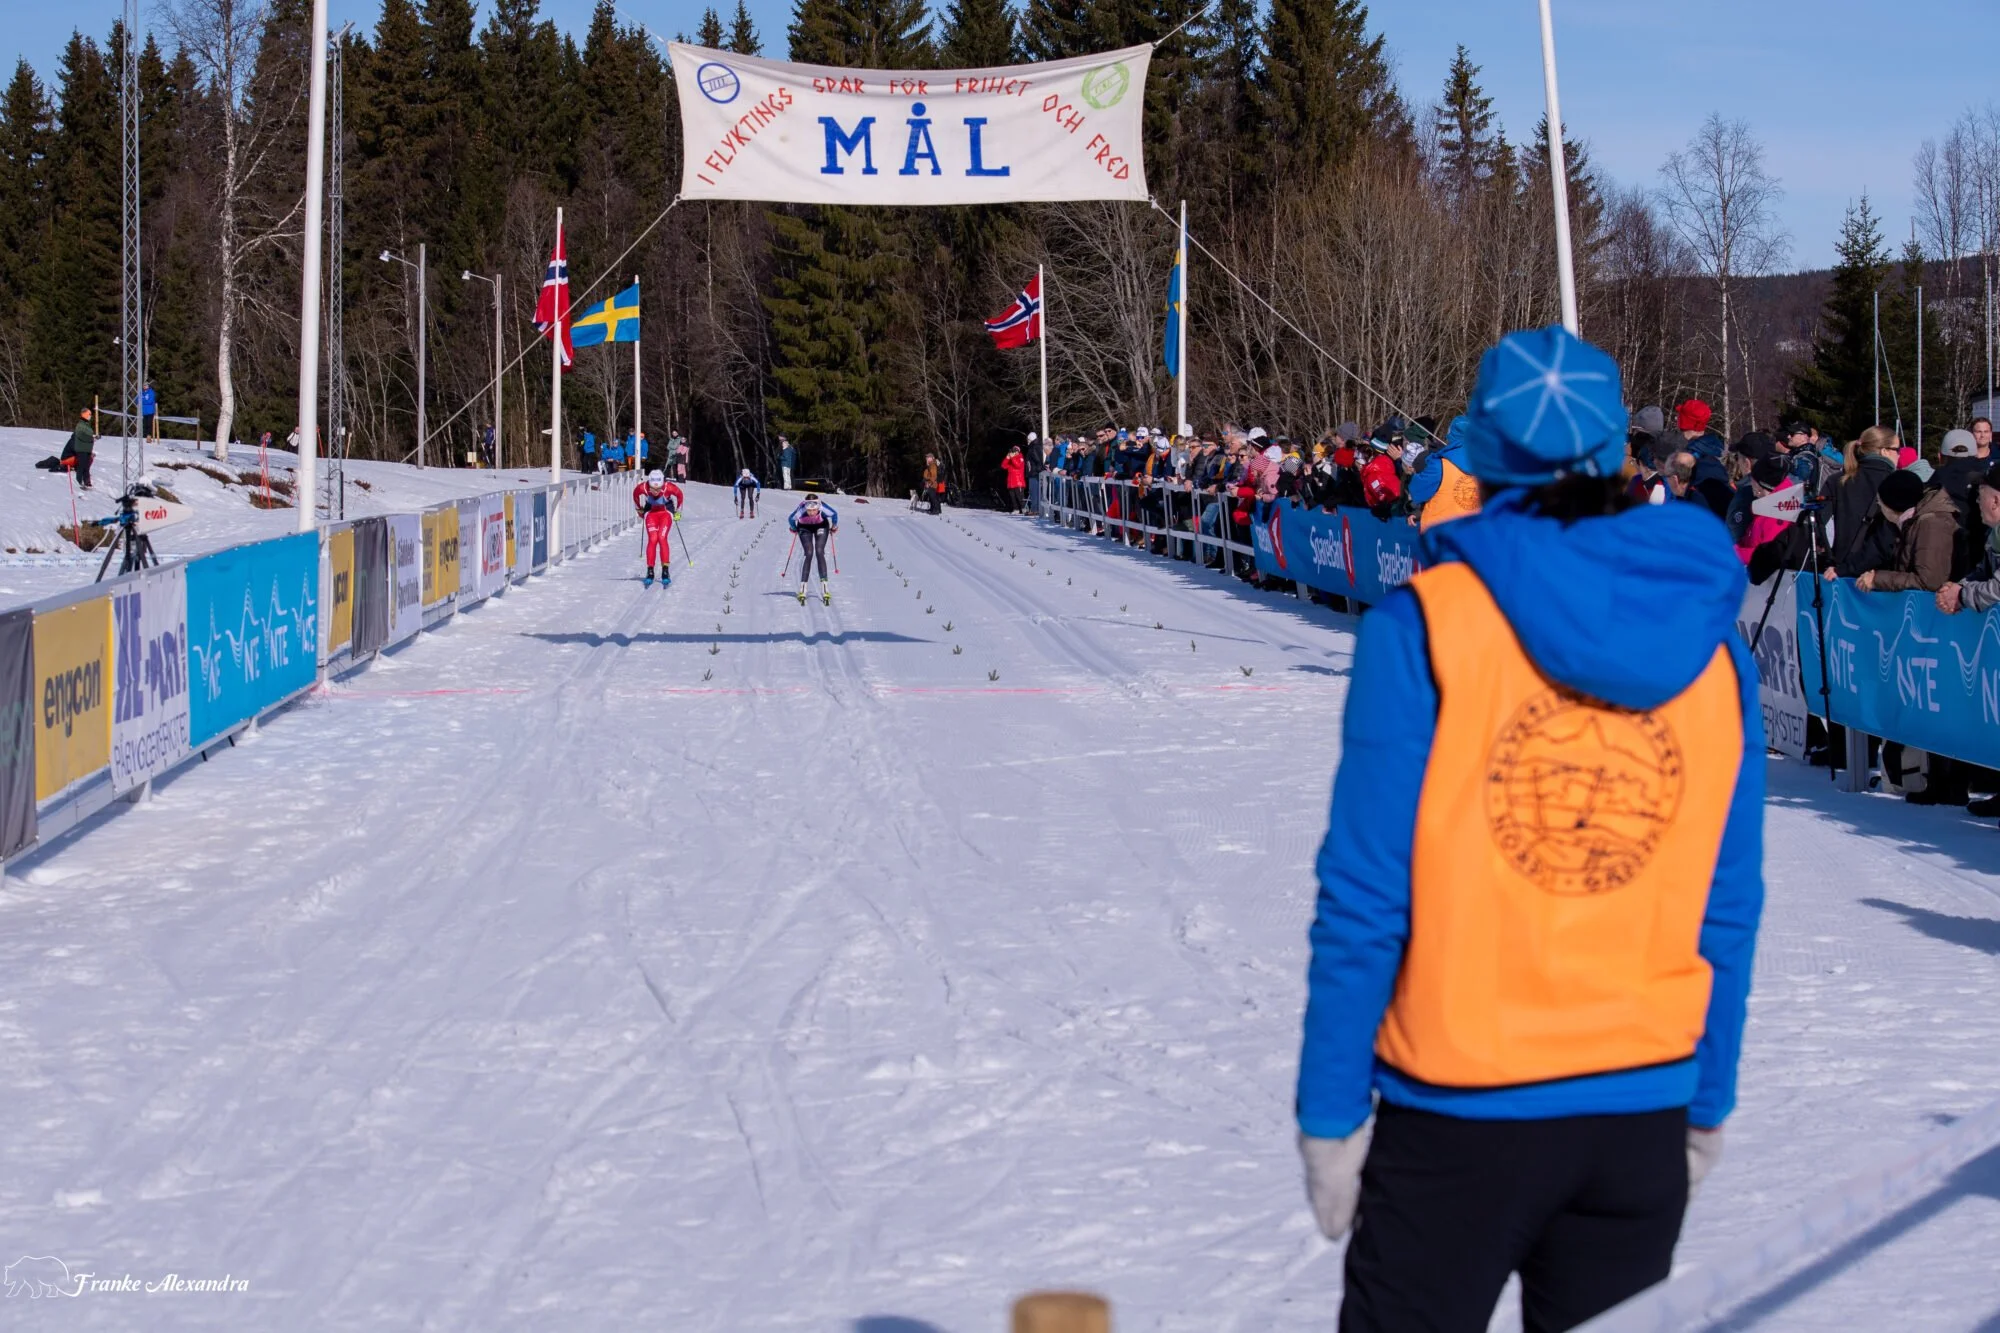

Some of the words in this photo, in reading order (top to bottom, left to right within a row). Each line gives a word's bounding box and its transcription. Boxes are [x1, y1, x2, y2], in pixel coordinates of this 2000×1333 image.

[812, 76, 865, 94] SPÅR
[889, 77, 928, 95] FÖR
[955, 76, 1033, 96] FRIHET
[705, 87, 792, 173] FLYKTINGS
[1043, 94, 1085, 134] OCH
[818, 102, 1010, 177] MÅL
[1086, 133, 1129, 179] FRED
[697, 173, 715, 185] I
[145, 506, 167, 520] emit
[1309, 525, 1346, 575] SpareBank
[270, 625, 288, 670] NTE
[1829, 637, 1859, 695] NTE
[43, 659, 101, 738] engcon
[208, 651, 221, 702] NE
[1896, 655, 1940, 713] NTE
